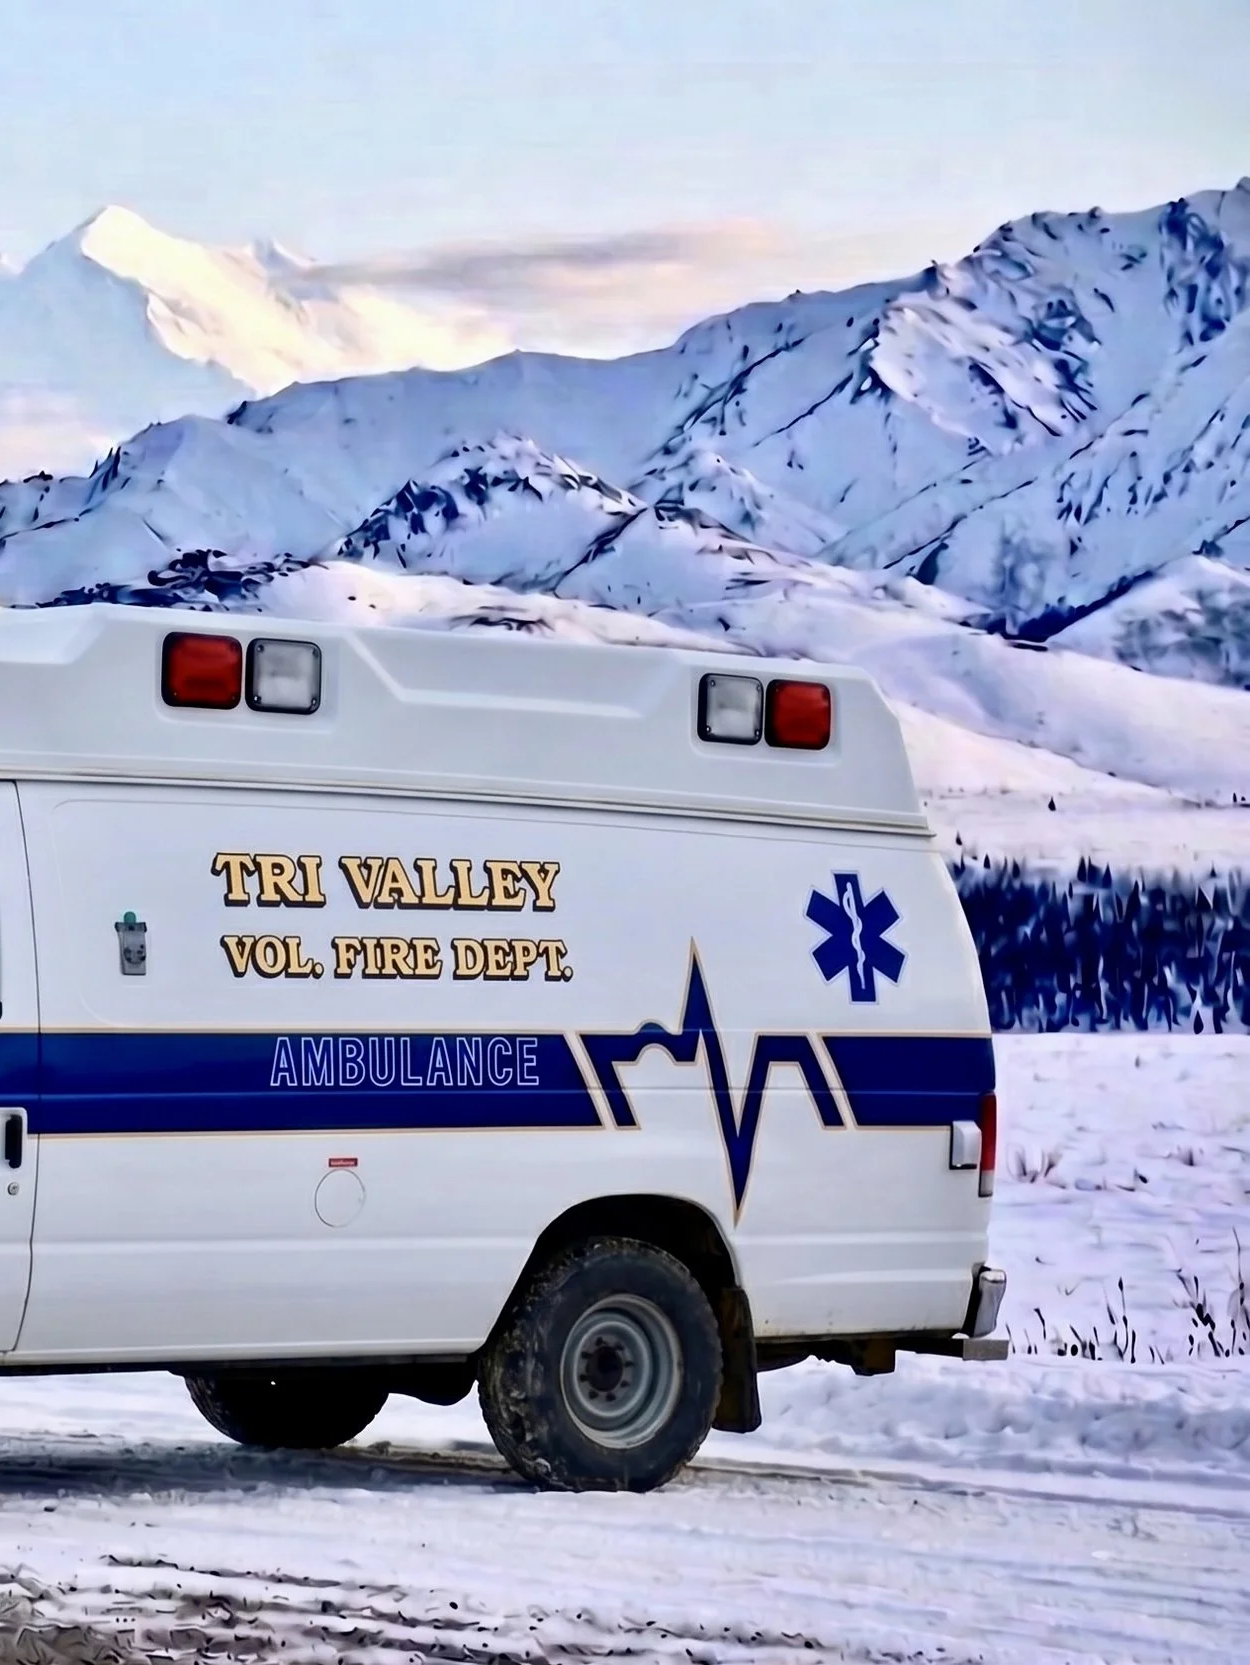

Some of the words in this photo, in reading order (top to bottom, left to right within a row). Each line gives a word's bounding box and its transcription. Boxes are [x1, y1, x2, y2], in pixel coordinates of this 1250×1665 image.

[211, 853, 326, 906] TRI
[339, 856, 560, 911] VALLEY
[220, 935, 324, 978] VOL.
[331, 936, 443, 981] FIRE
[452, 938, 573, 981] DEPT.
[270, 1037, 539, 1087] AMBULANCE
